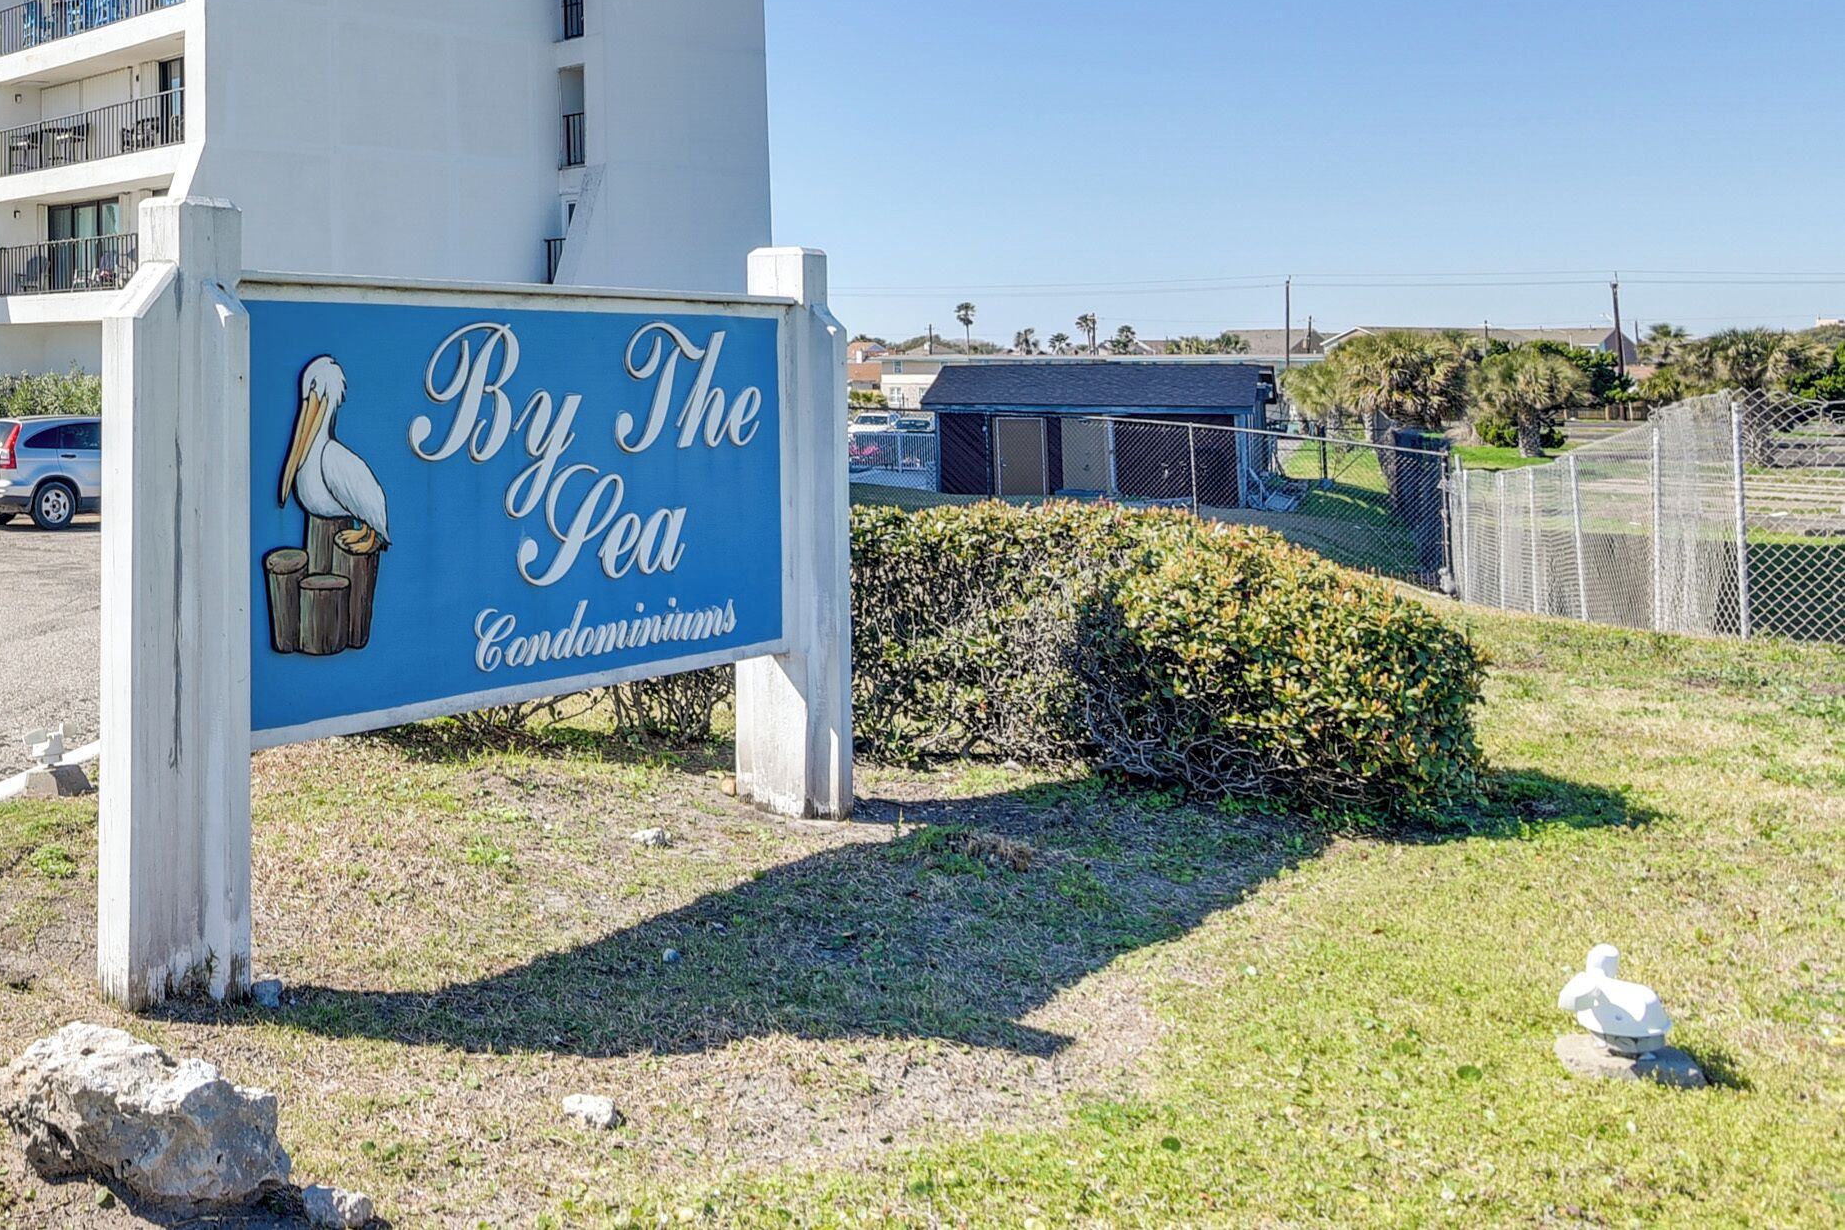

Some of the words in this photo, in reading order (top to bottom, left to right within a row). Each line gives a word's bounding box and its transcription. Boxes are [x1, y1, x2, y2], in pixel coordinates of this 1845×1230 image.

[408, 321, 582, 519] By
[615, 320, 763, 454] The
[516, 464, 687, 587] Sea
[474, 597, 738, 673] Condominiums
